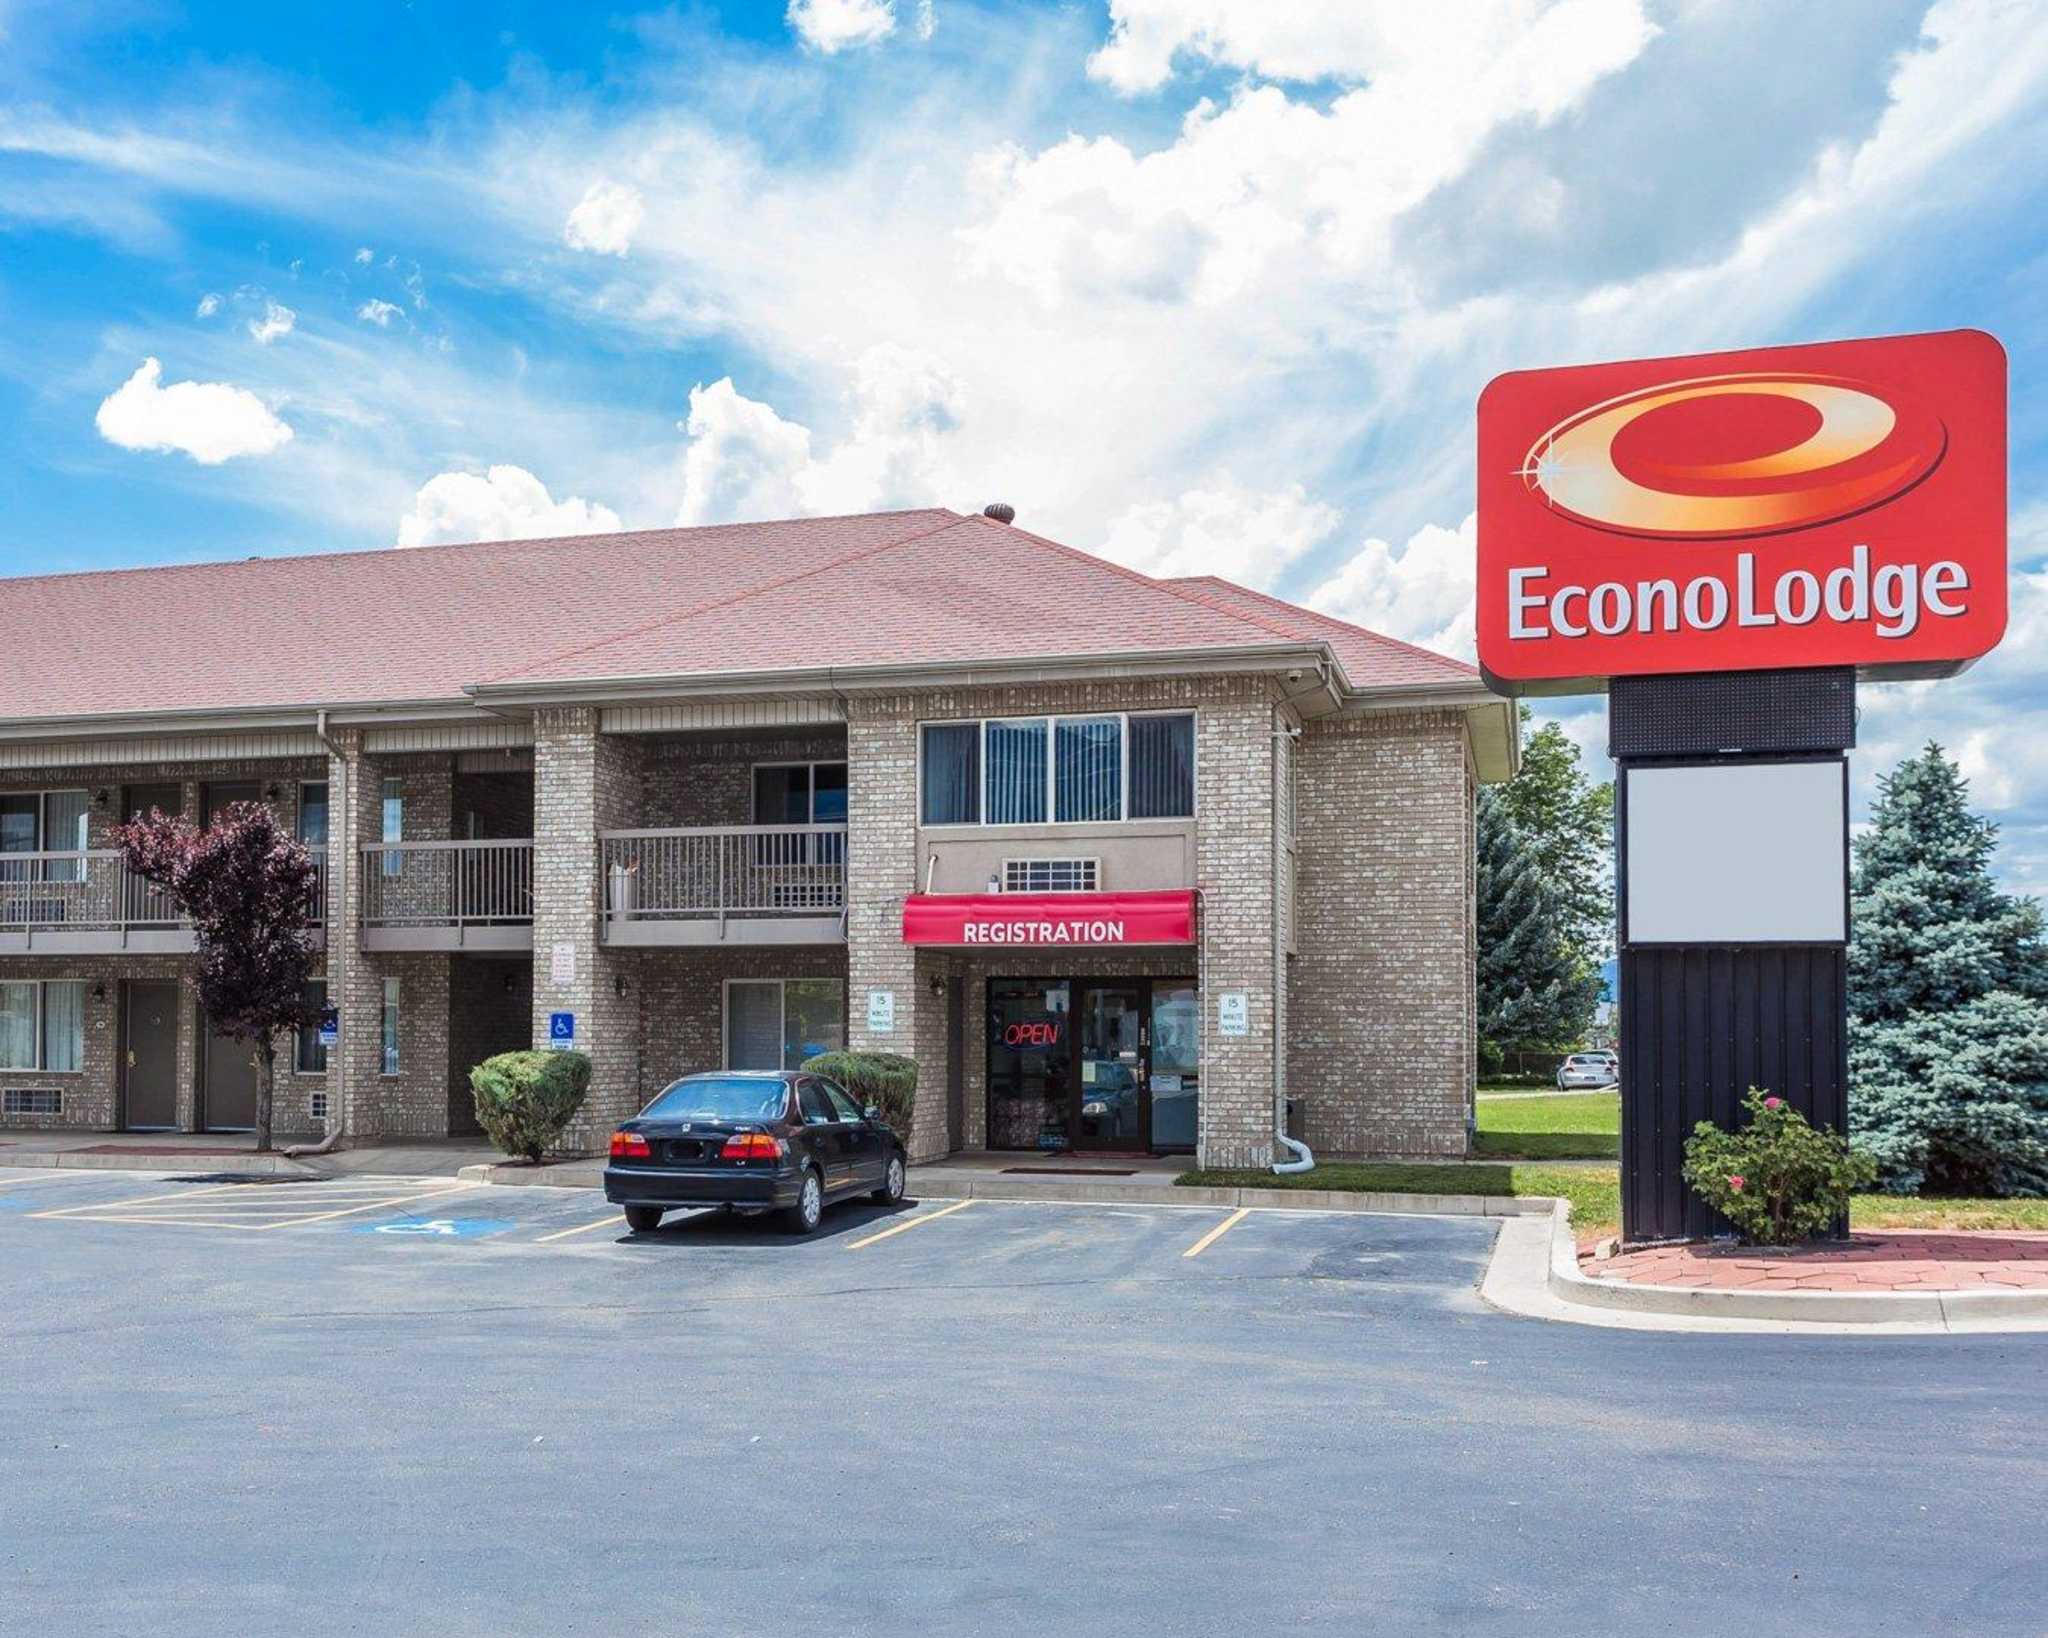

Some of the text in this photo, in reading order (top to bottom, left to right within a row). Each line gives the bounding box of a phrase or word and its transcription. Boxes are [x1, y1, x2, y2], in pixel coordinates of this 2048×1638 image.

[963, 921, 1124, 943] REGISTRATION
[1228, 998, 1239, 1008] 15
[1005, 1024, 1059, 1045] OPEN
